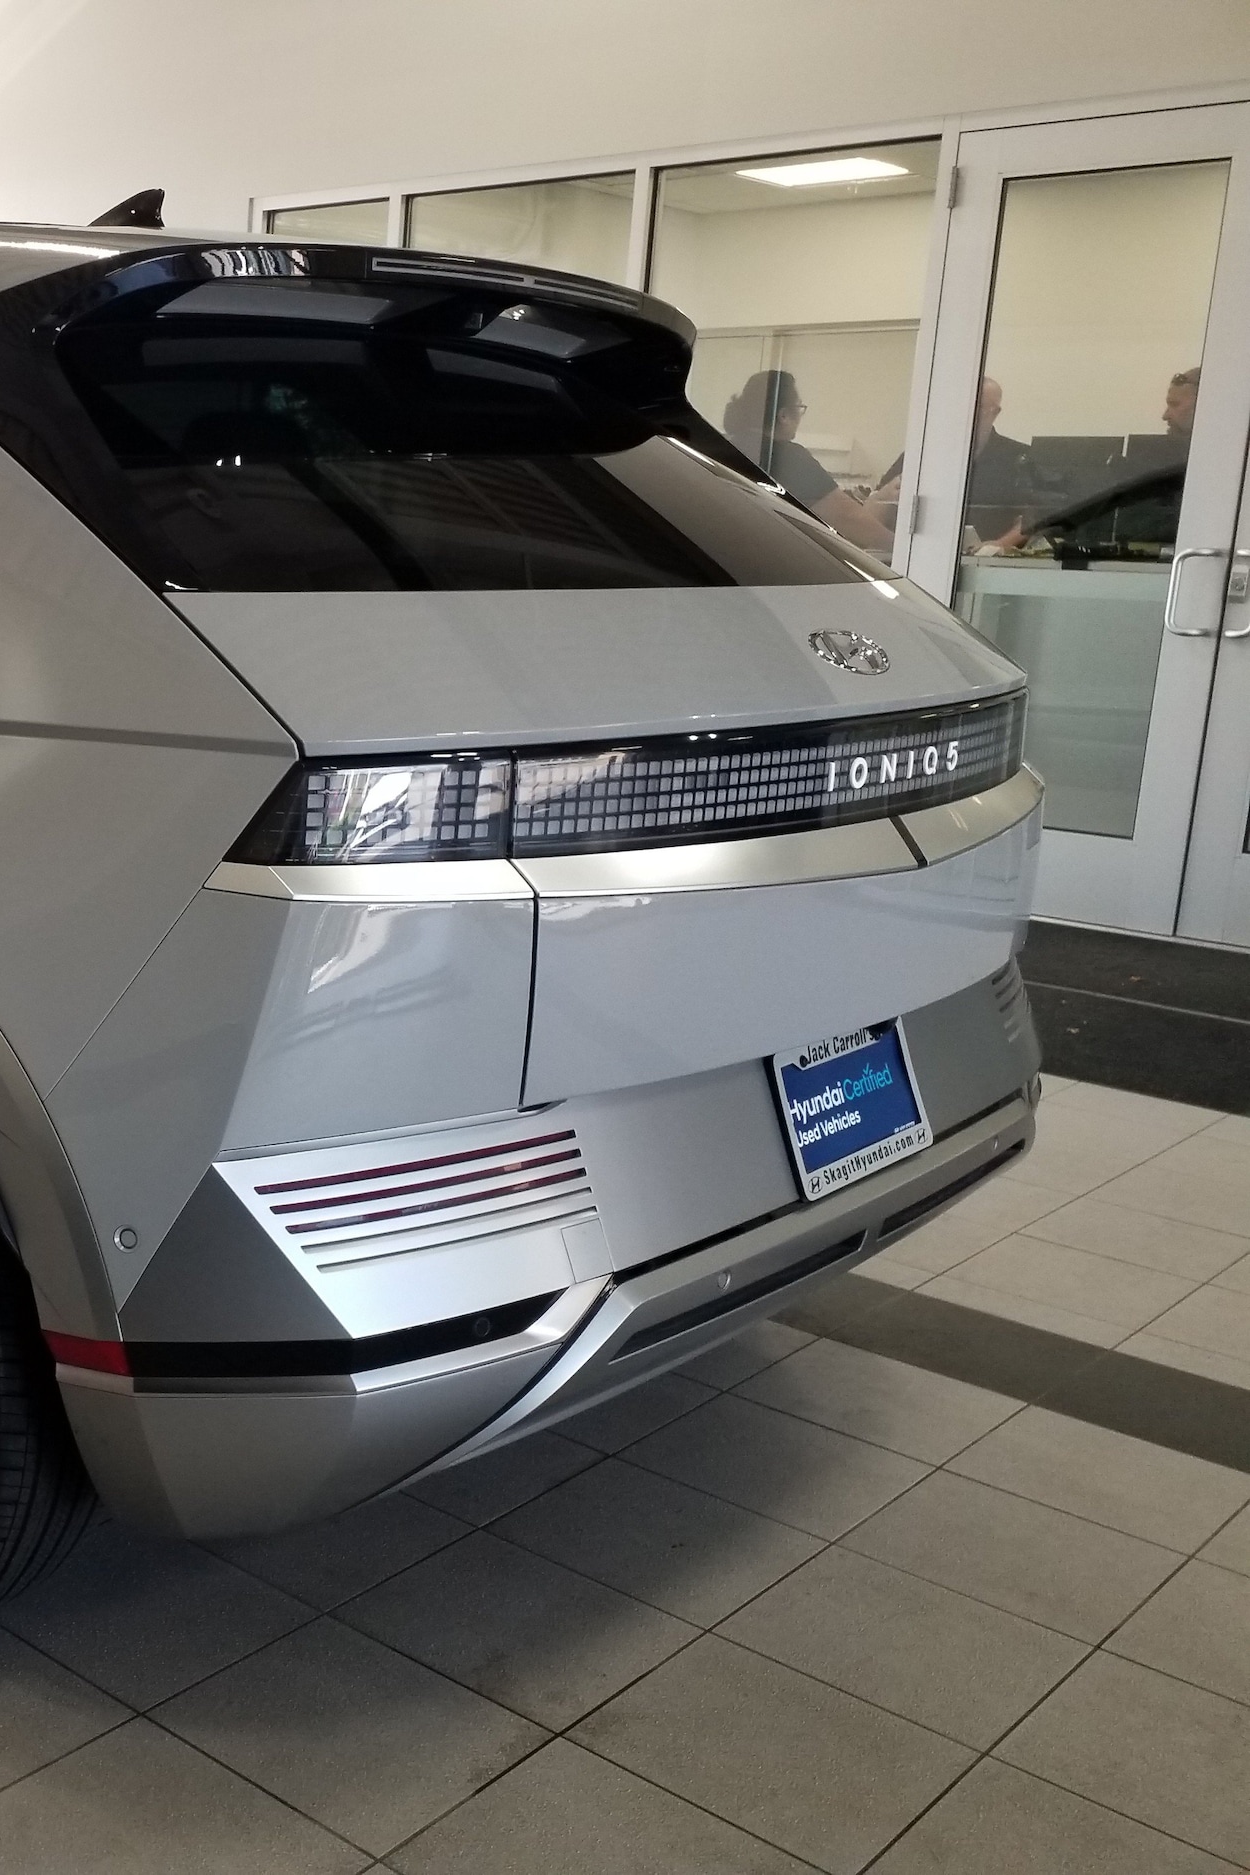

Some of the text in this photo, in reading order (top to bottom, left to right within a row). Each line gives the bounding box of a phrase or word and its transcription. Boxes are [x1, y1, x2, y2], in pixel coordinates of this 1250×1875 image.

[827, 741, 959, 792] IONIQ 5
[807, 1039, 831, 1065] Jack
[843, 1062, 893, 1100] Certified
[820, 1110, 861, 1137] Vehicles
[823, 1134, 915, 1185] SkagitHyundai.com
